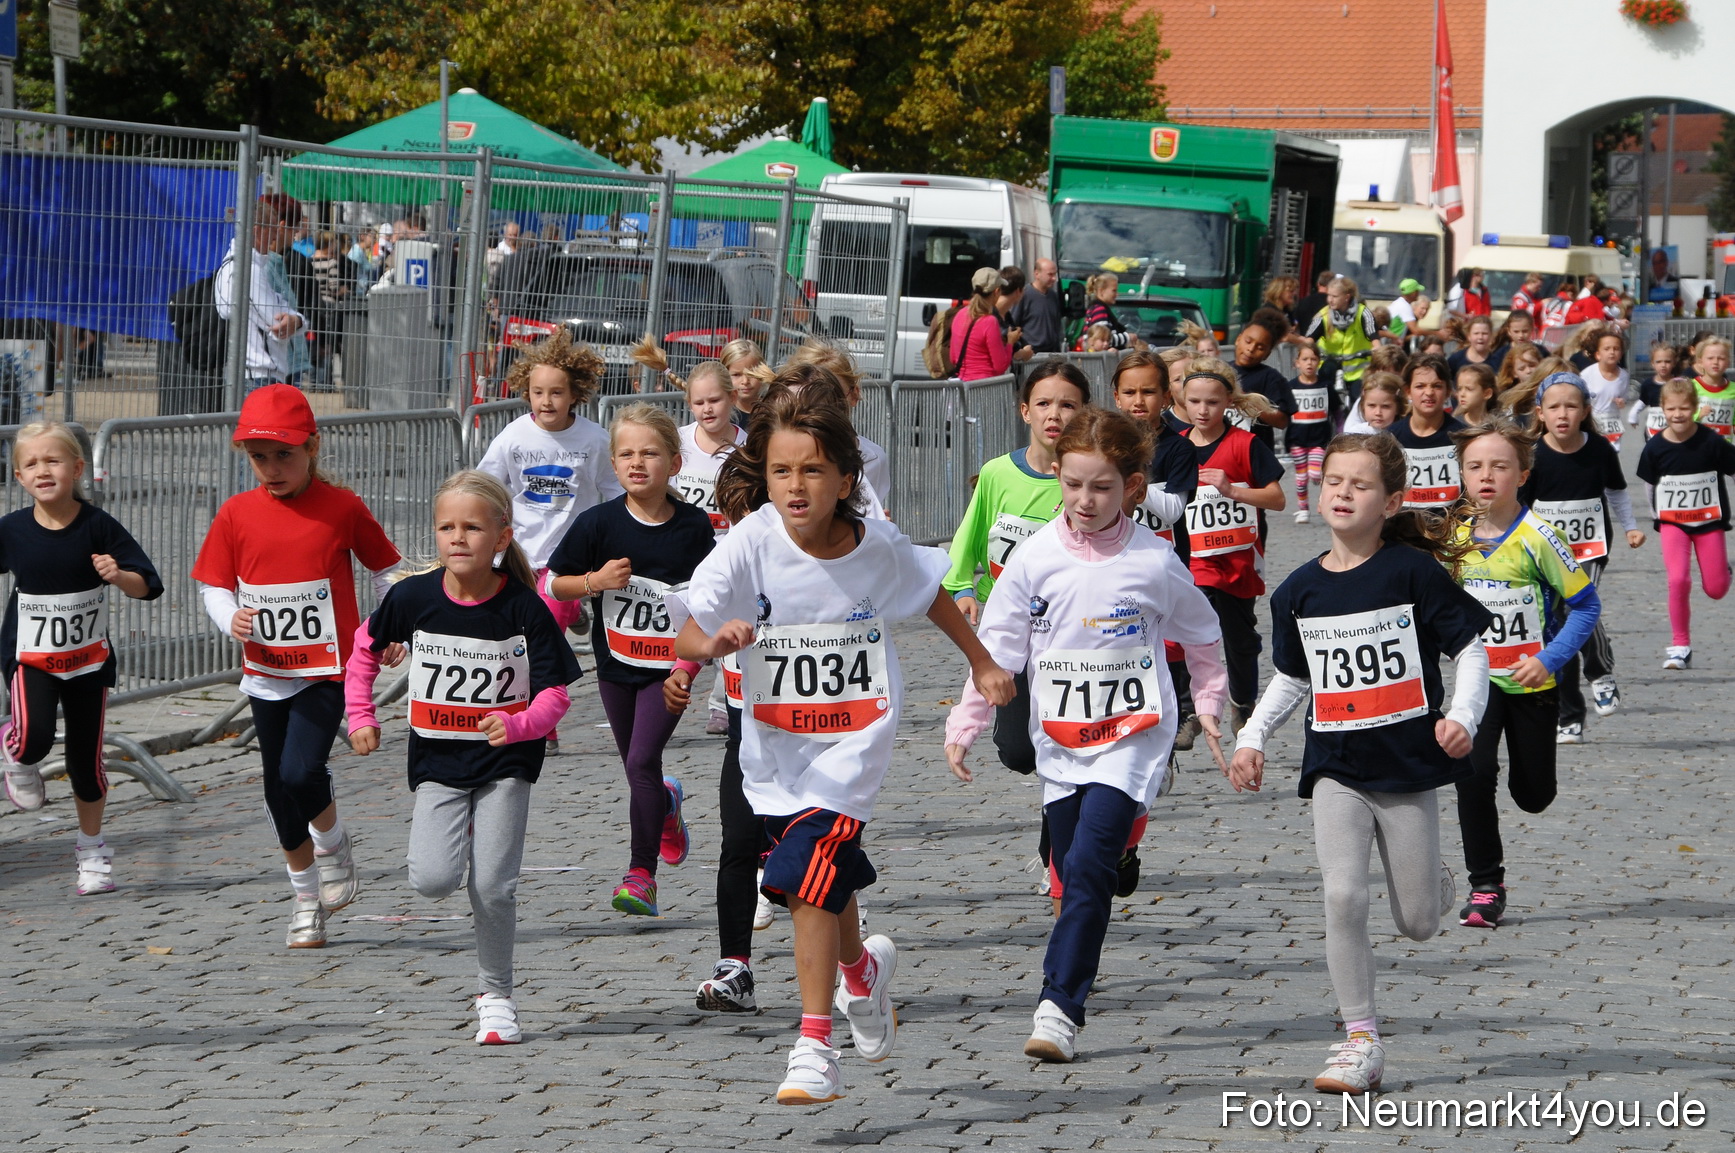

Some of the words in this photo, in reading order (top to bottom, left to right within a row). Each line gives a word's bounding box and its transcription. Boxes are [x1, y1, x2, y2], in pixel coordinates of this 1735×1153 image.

[410, 264, 424, 286] P
[1706, 408, 1731, 424] 322
[1410, 463, 1452, 486] 214
[680, 485, 719, 512] 724
[1664, 486, 1712, 509] 7270
[1187, 500, 1247, 530] 7035
[1558, 506, 1593, 515] Neumarkt
[996, 520, 1025, 537] PARTL
[1204, 533, 1235, 547] Elena
[1537, 524, 1581, 574] BOCK
[20, 602, 51, 612] PARTL
[53, 598, 96, 612] Neumarkt
[260, 592, 312, 604] Neumarkt
[1480, 597, 1519, 608] eumarkt
[243, 604, 323, 642] 026
[613, 595, 677, 633] 703
[30, 608, 99, 648] 7037
[1302, 628, 1332, 641] PARTL
[1333, 620, 1393, 639] Neumarkt
[415, 641, 450, 657] PARTL
[453, 647, 510, 661] Neumarkt
[630, 641, 670, 657] Mona
[757, 638, 797, 649] ARTL
[800, 633, 863, 649] Neumarkt
[45, 652, 90, 672] Sophia
[261, 648, 309, 669] Sophia
[1039, 660, 1078, 672] PARTL
[1080, 659, 1136, 672] Neumarkt
[1315, 637, 1407, 689] 7395
[421, 661, 516, 704] 7222
[764, 649, 873, 698] 7034
[1051, 677, 1146, 719] 7179
[792, 709, 852, 732] Erjona
[1319, 703, 1345, 717] Sophia
[1079, 723, 1120, 744] Sofia
